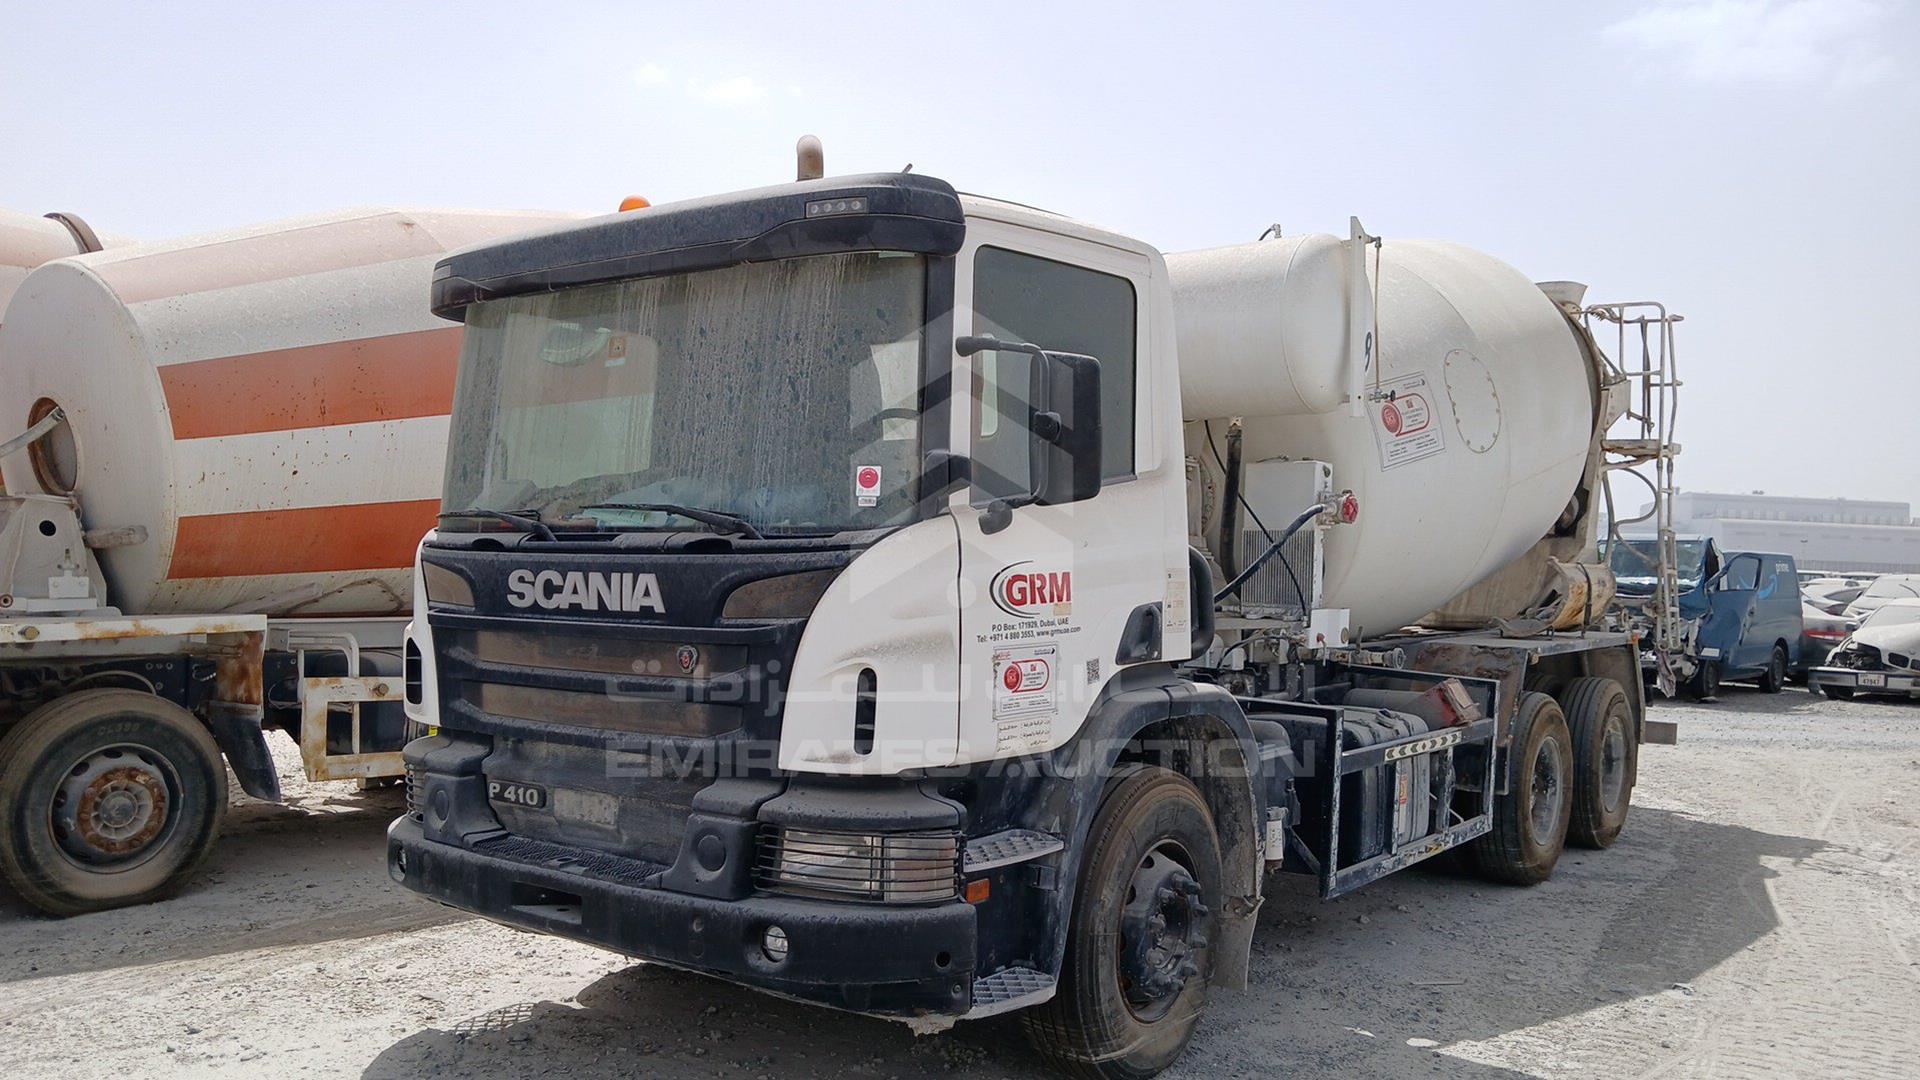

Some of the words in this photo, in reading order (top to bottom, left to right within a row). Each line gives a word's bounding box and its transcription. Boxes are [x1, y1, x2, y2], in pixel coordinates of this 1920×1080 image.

[506, 568, 666, 613] SCANIA
[1005, 571, 1072, 608] GRM
[1003, 623, 1017, 632] Box:
[1057, 617, 1069, 626] UAE
[989, 633, 1004, 642] +971
[1004, 632, 1009, 640] 4
[489, 782, 501, 798] P
[504, 785, 539, 806] 410
